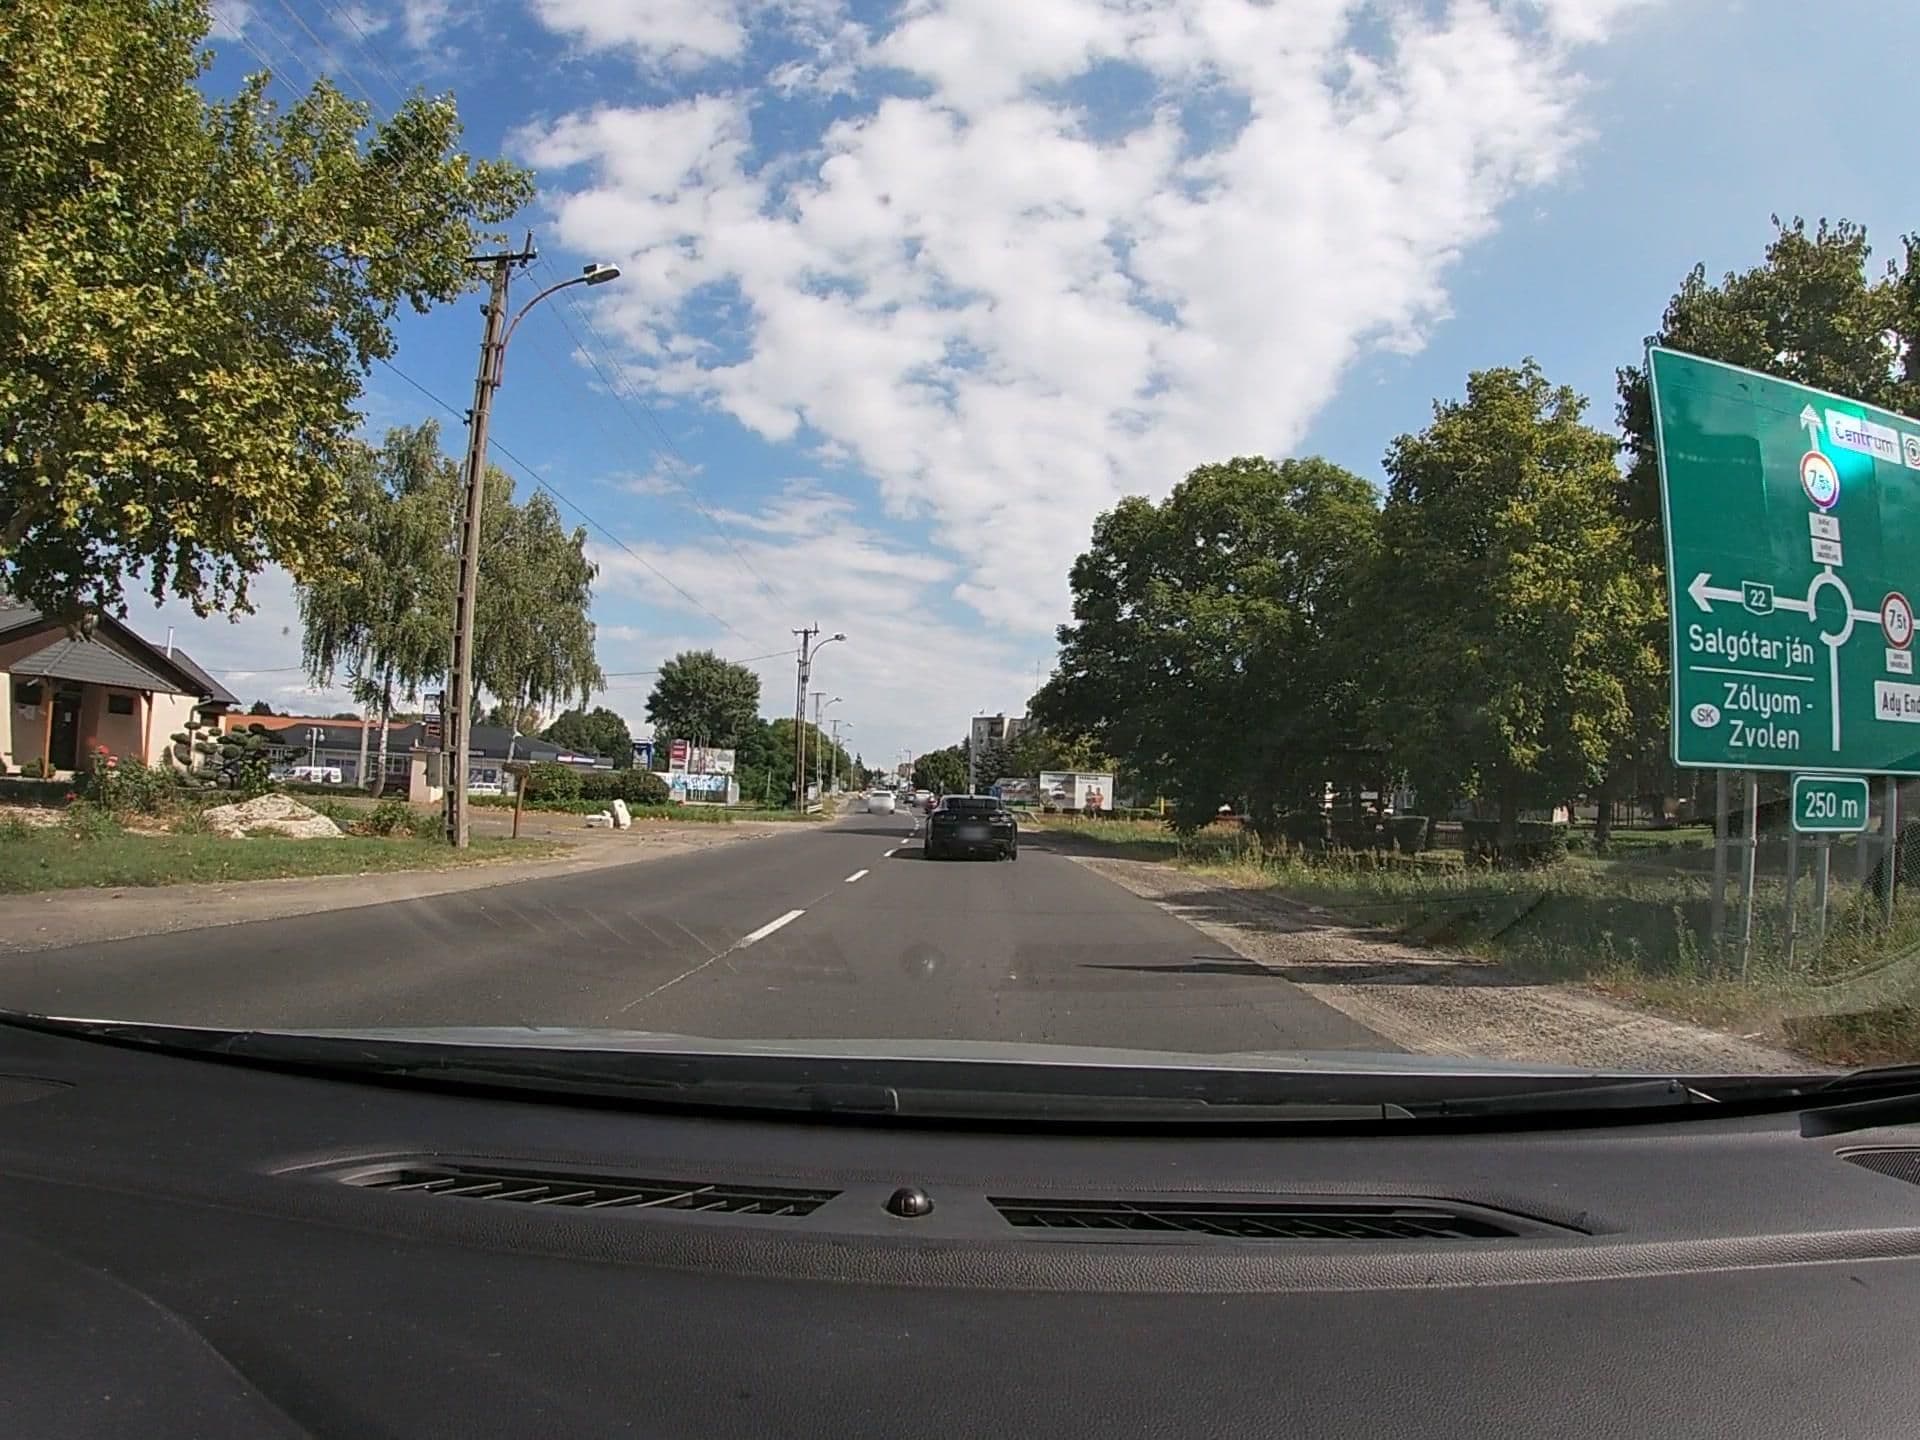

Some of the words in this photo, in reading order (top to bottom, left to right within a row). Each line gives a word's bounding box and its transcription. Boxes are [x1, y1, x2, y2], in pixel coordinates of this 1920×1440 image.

[1834, 420, 1897, 455] Centrum
[1750, 589, 1767, 607] 22
[1689, 623, 1814, 668] Salgótarján
[1697, 708, 1714, 722] SK
[1723, 682, 1801, 719] Zólyom
[1882, 691, 1901, 717] Ady
[1728, 719, 1800, 750] Zvolen
[1805, 791, 1836, 818] 250
[1841, 799, 1858, 818] m
